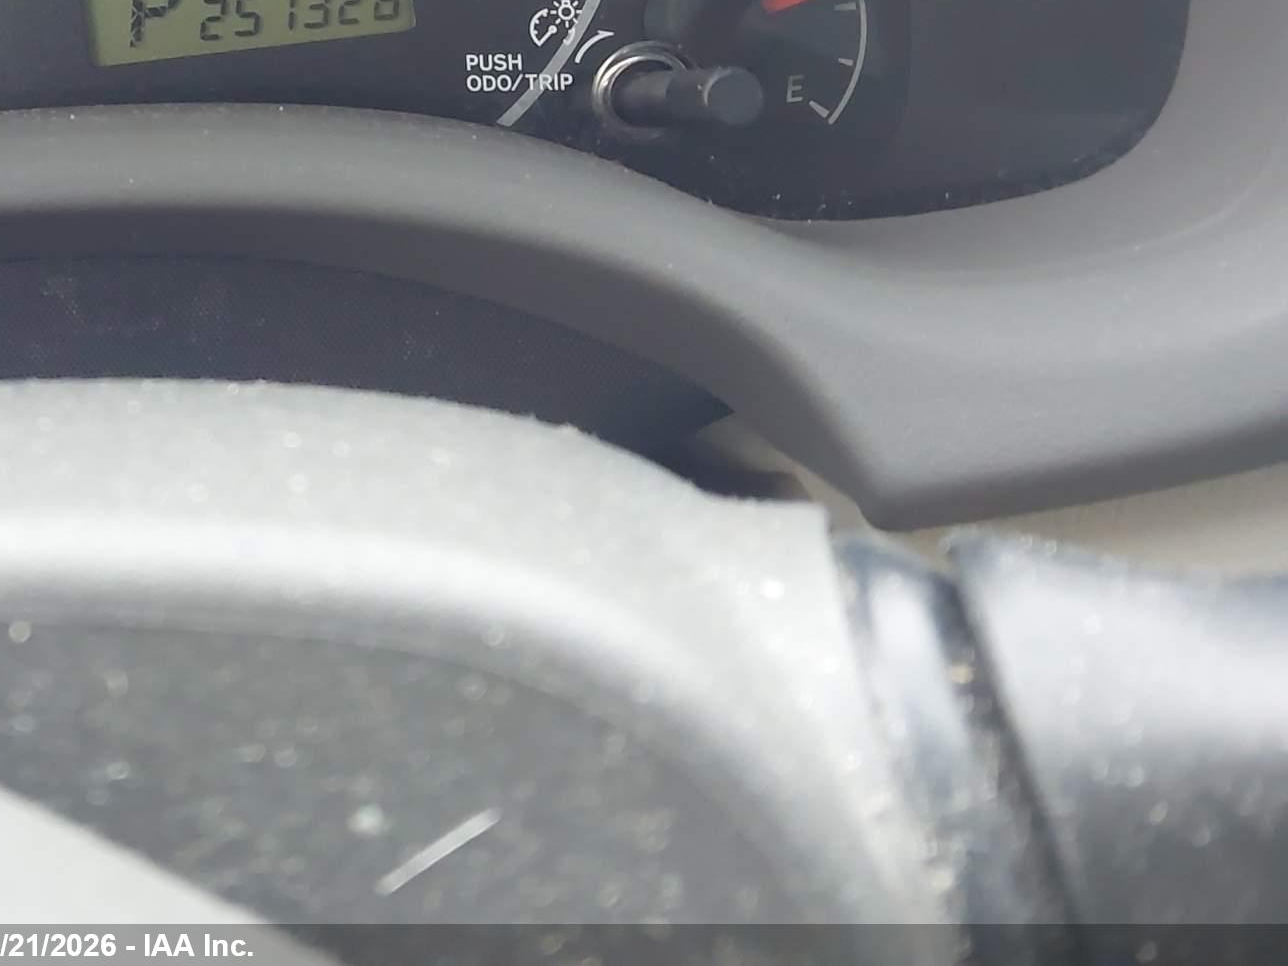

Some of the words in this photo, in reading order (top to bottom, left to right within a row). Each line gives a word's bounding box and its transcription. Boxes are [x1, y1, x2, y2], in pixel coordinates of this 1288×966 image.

[466, 54, 523, 72] PUSH
[466, 74, 573, 92] ODO/TRIP
[786, 75, 804, 102] E
